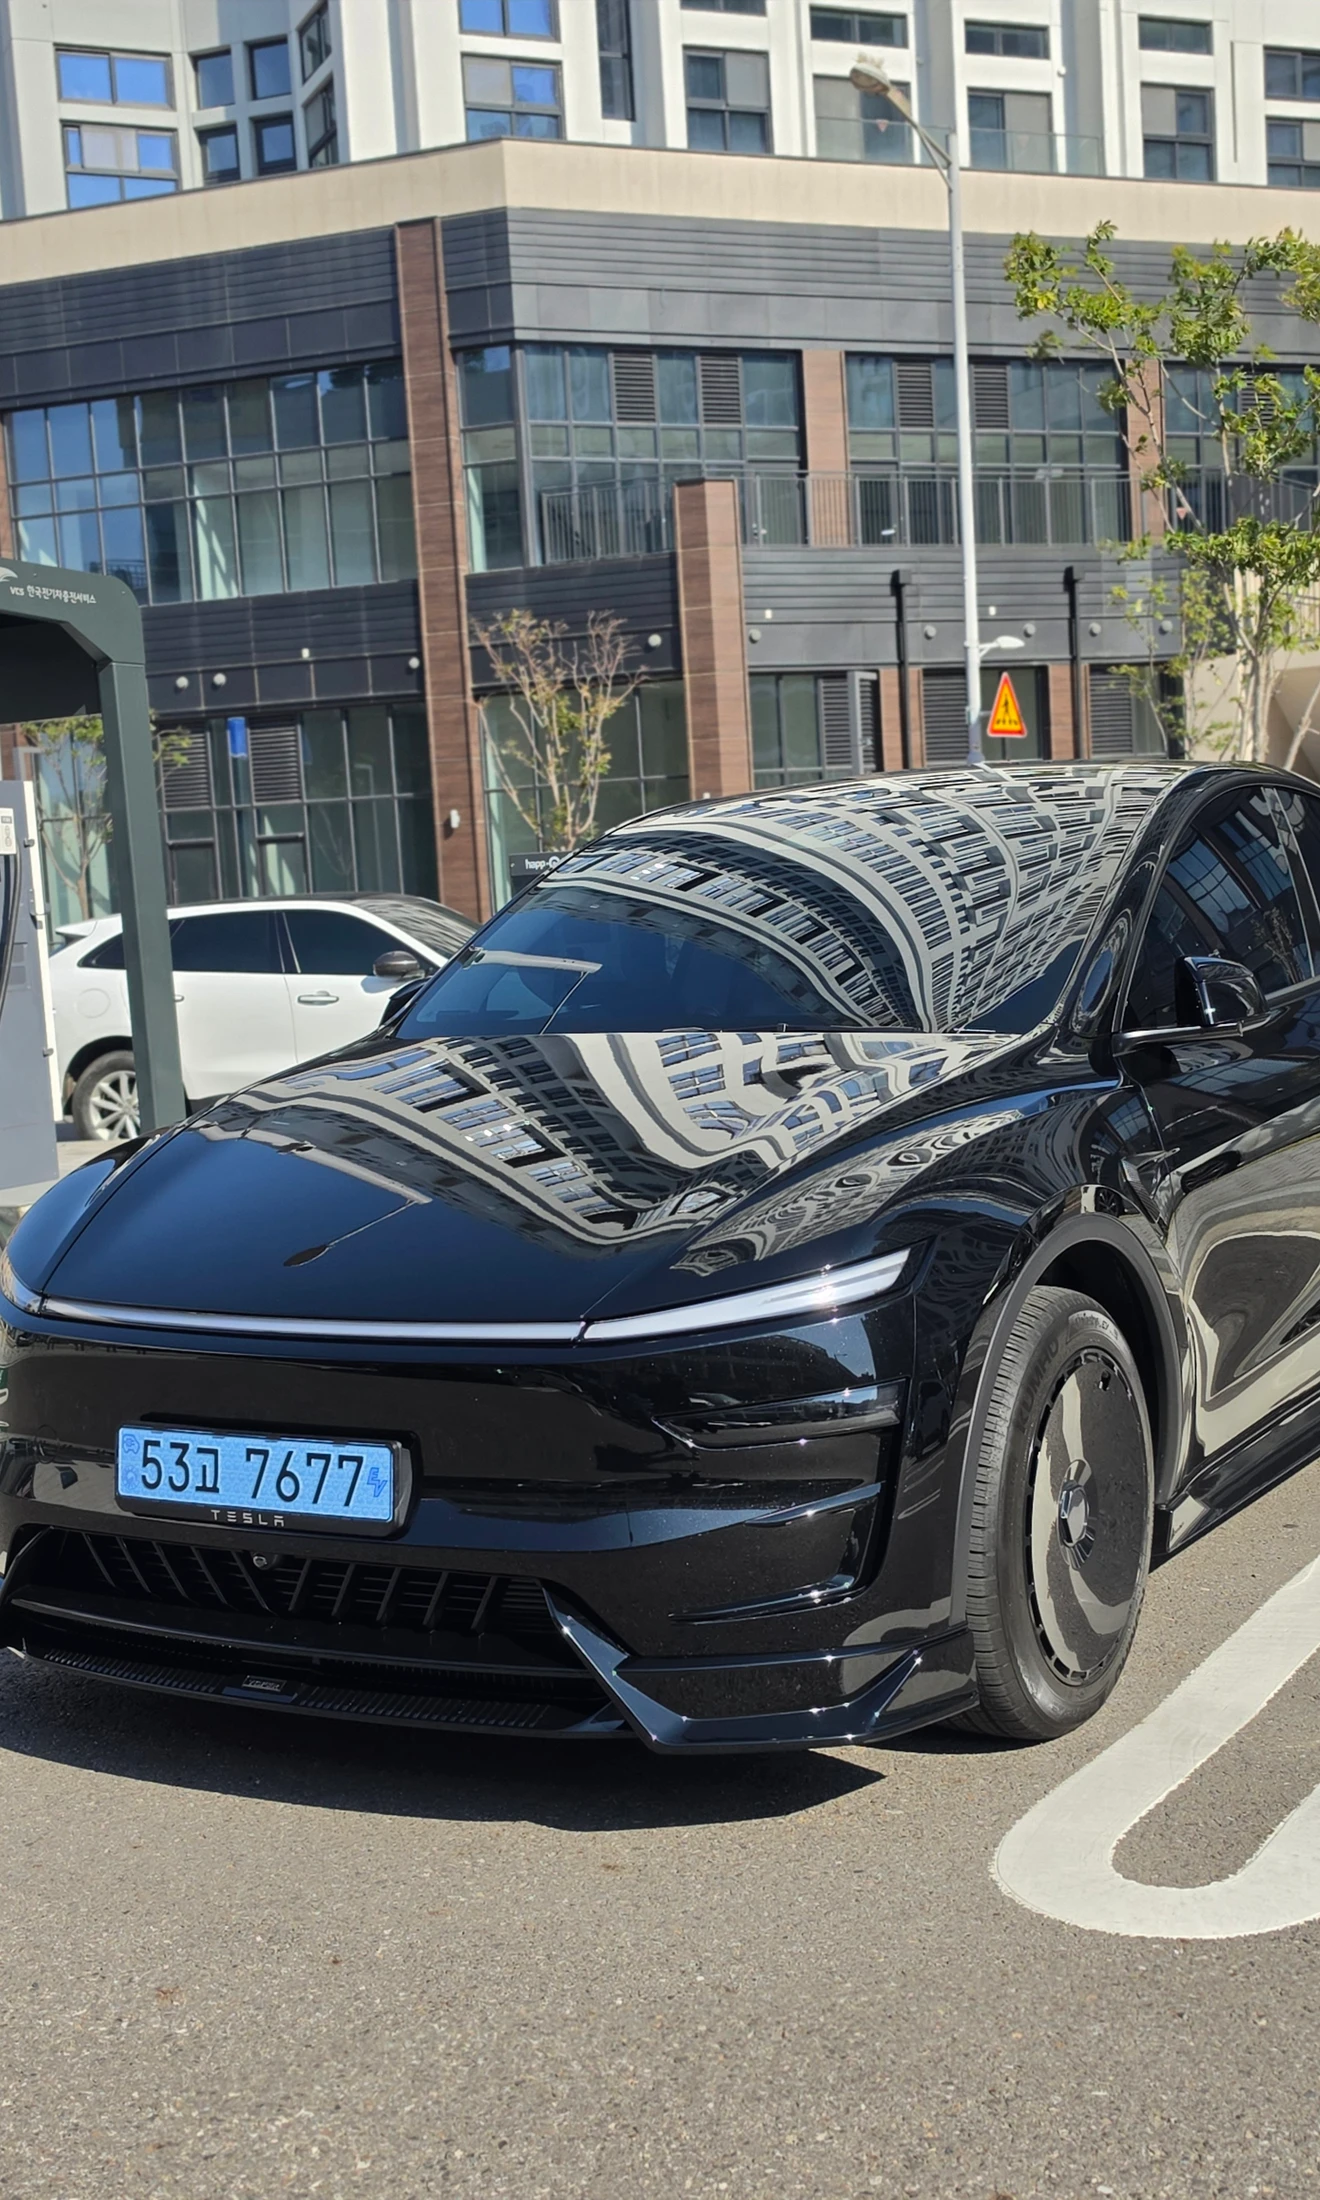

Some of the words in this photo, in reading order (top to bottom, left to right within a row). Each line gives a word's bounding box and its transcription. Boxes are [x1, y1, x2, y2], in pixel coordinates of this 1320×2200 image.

[140, 1439, 220, 1493] 53고
[245, 1447, 365, 1507] 7677
[366, 1467, 388, 1498] EV
[210, 1509, 285, 1528] TESLA
